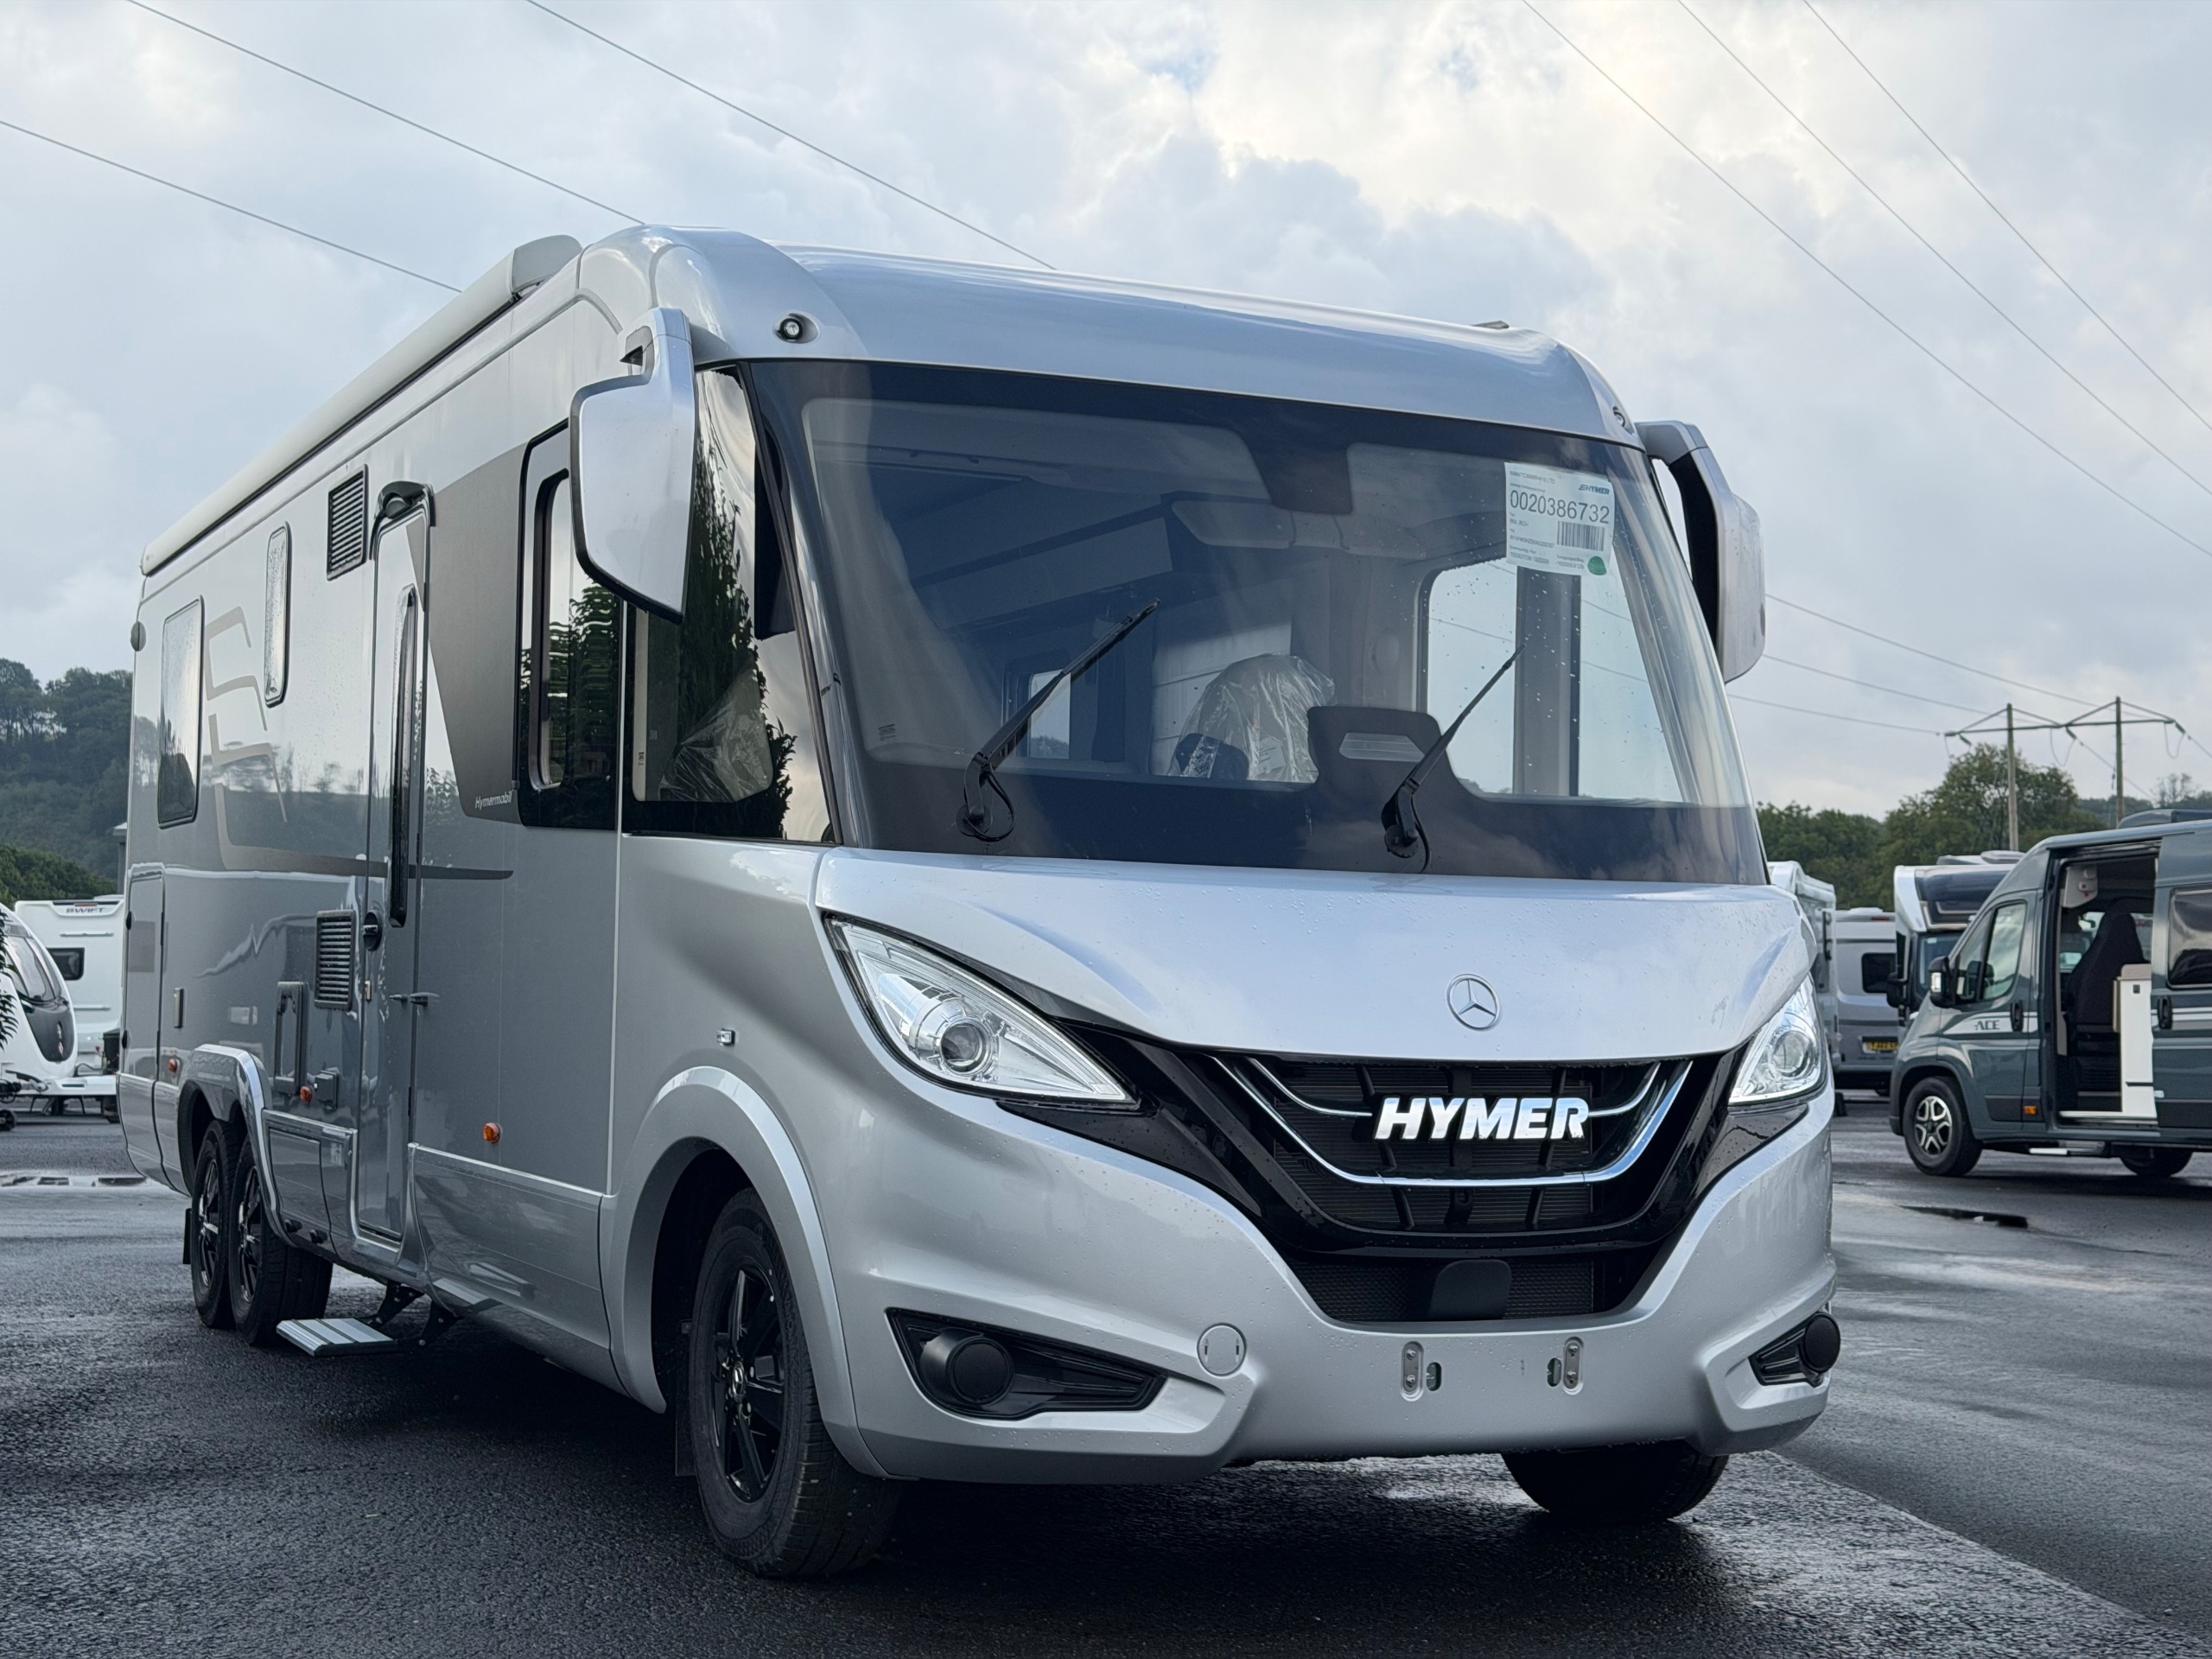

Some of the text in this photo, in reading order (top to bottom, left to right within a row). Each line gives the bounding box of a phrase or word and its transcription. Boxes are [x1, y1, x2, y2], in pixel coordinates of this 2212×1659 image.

[1510, 490, 1610, 524] 0020386732
[474, 790, 514, 810] Hymermobil
[1974, 1020, 2000, 1031] ACE
[1374, 1096, 1590, 1141] HYMER
